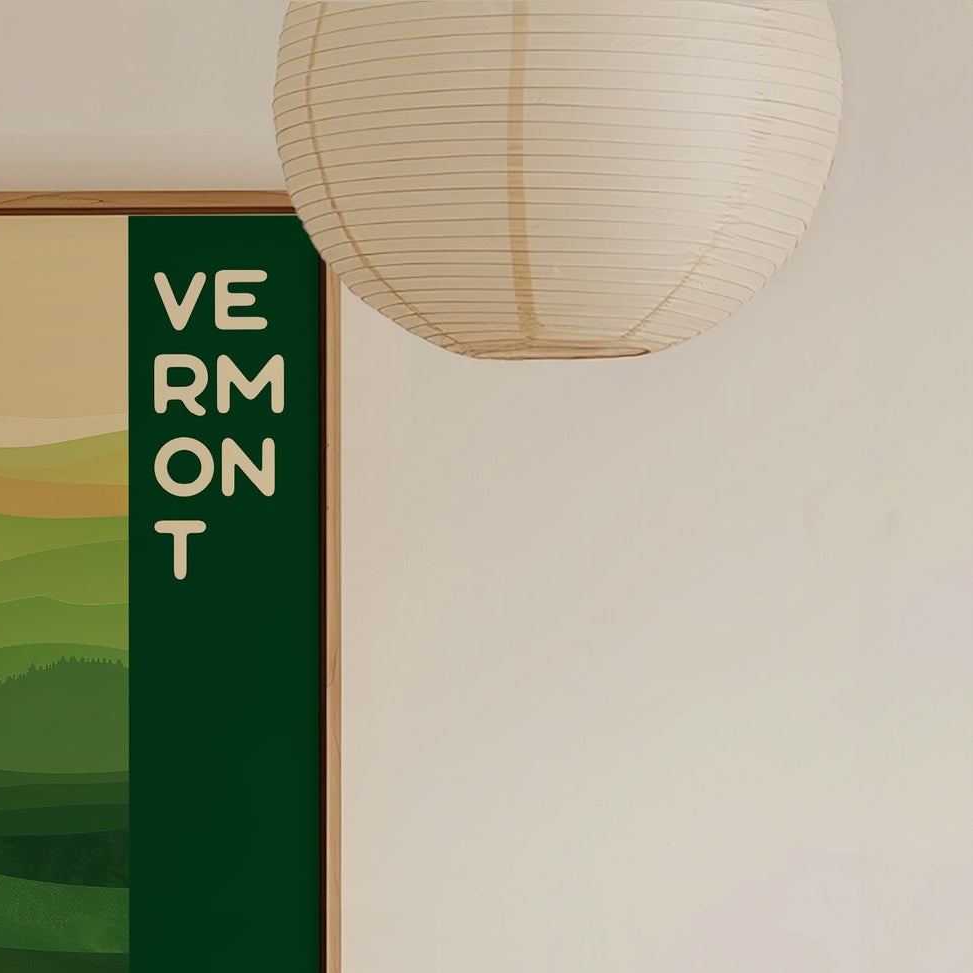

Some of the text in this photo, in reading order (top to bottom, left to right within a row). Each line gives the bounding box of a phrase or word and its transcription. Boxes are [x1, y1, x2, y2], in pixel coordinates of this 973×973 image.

[154, 269, 268, 331] VE
[154, 354, 285, 416] RM
[154, 437, 276, 497] ON
[154, 520, 207, 580] T
